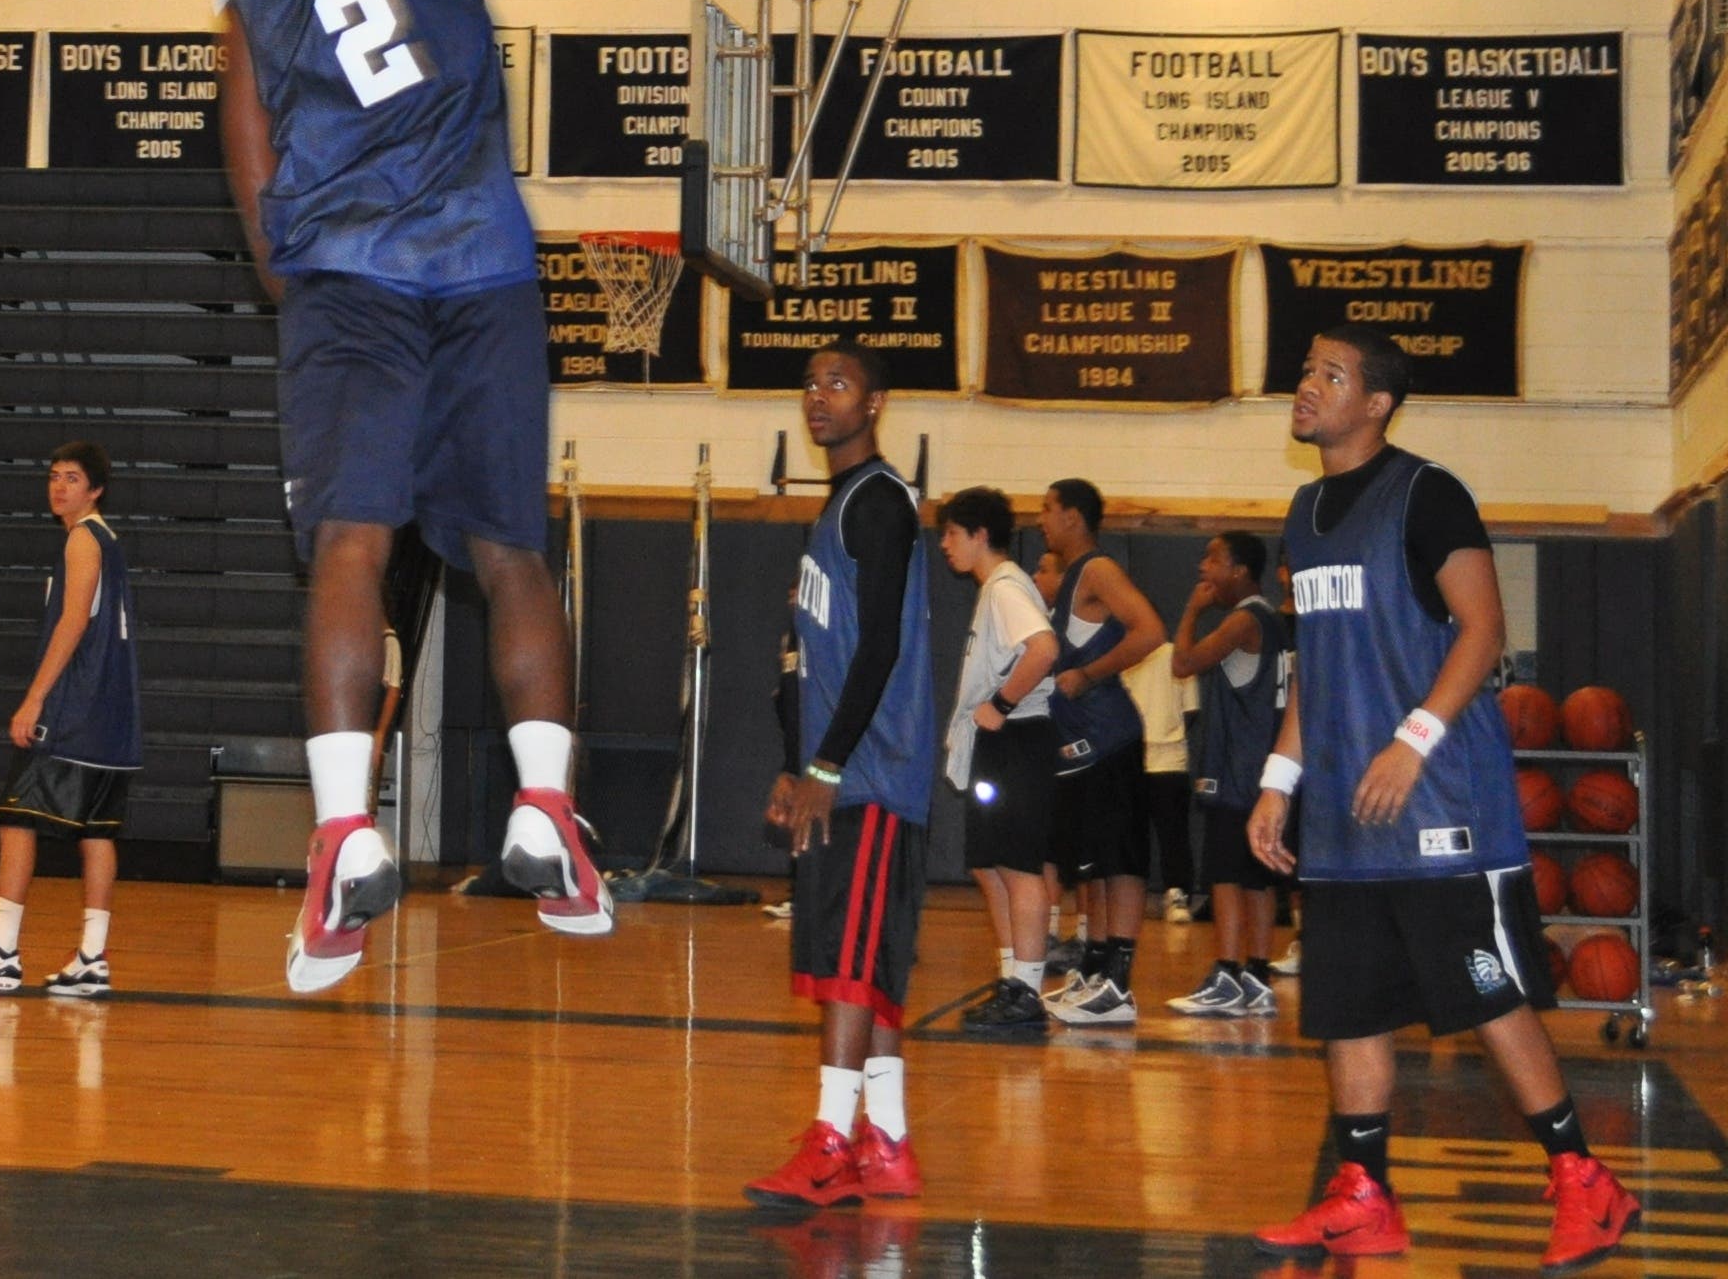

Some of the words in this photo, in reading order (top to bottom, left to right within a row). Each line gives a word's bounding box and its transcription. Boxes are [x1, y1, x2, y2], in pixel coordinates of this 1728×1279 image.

[61, 44, 121, 72] BOYS
[1130, 51, 1284, 79] FOOTBALL
[1360, 47, 1429, 76] BOYS
[1445, 47, 1618, 77] BASKETBALL
[104, 81, 148, 100] LONG
[159, 81, 218, 100] ISLAND
[899, 88, 970, 107] COUNTY
[1144, 90, 1190, 109] LONG
[1207, 90, 1270, 109] ISLAND
[1437, 89, 1512, 109] LEAGUE
[115, 111, 204, 130] CHAMPIONS
[884, 119, 983, 137] CHAMPIONS
[1435, 120, 1542, 141] CHAMPIONS
[1158, 122, 1257, 141] CHAMPIONS
[136, 140, 182, 159] 2005
[908, 148, 959, 168] 2005
[1182, 154, 1231, 173] 2005
[1445, 152, 1531, 172] 2005-06
[1038, 270, 1177, 292] WRESTLING
[1289, 258, 1494, 291] WRESTLING
[766, 297, 872, 322] LEAGUE
[1041, 301, 1134, 322] LEAGUE
[1346, 300, 1434, 321] COUNTY
[1024, 332, 1191, 355] CHAMPIONSHIP
